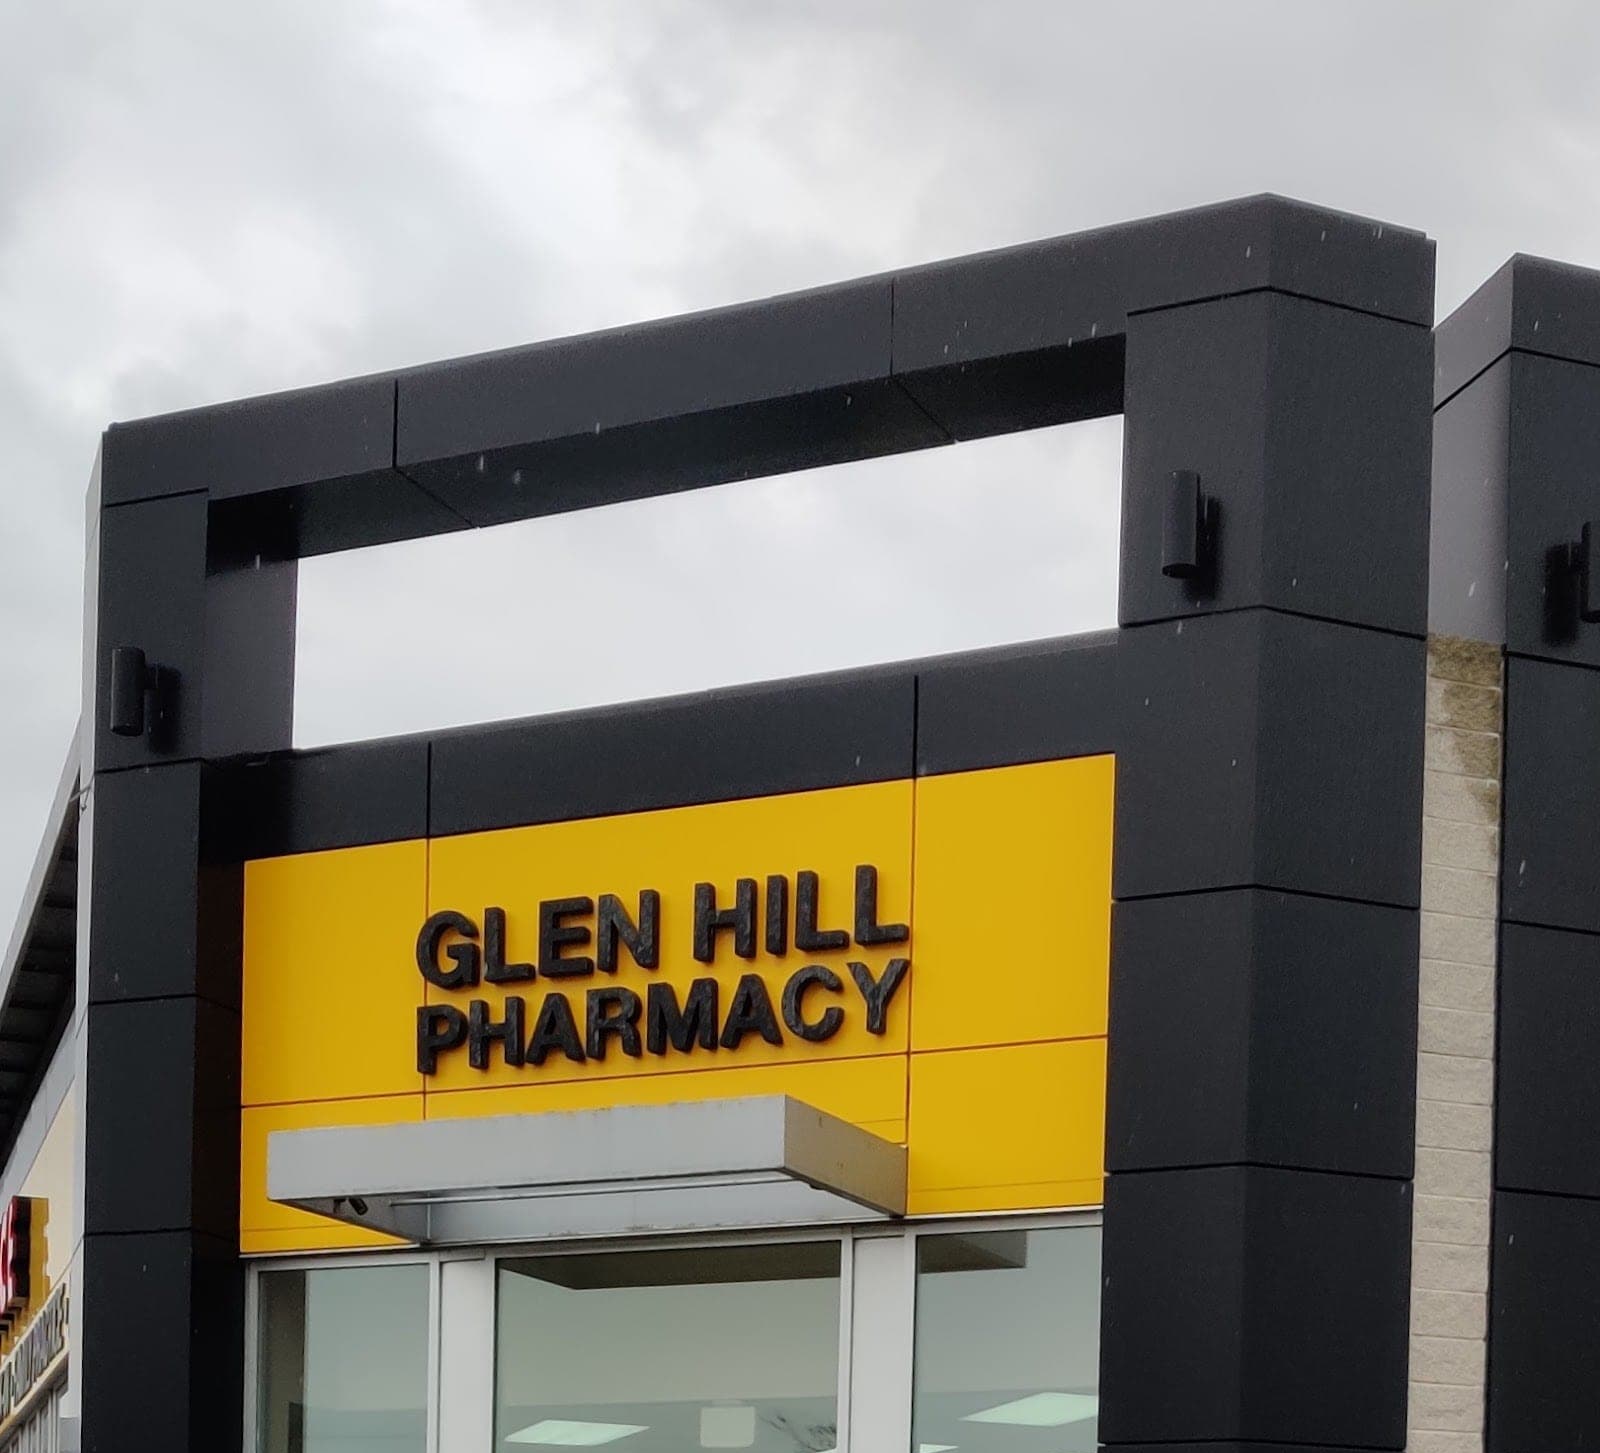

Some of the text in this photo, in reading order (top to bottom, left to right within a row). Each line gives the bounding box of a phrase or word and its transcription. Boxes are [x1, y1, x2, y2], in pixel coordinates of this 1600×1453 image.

[415, 864, 910, 990] GLEN HILL
[416, 958, 911, 1076] PHARMACY
